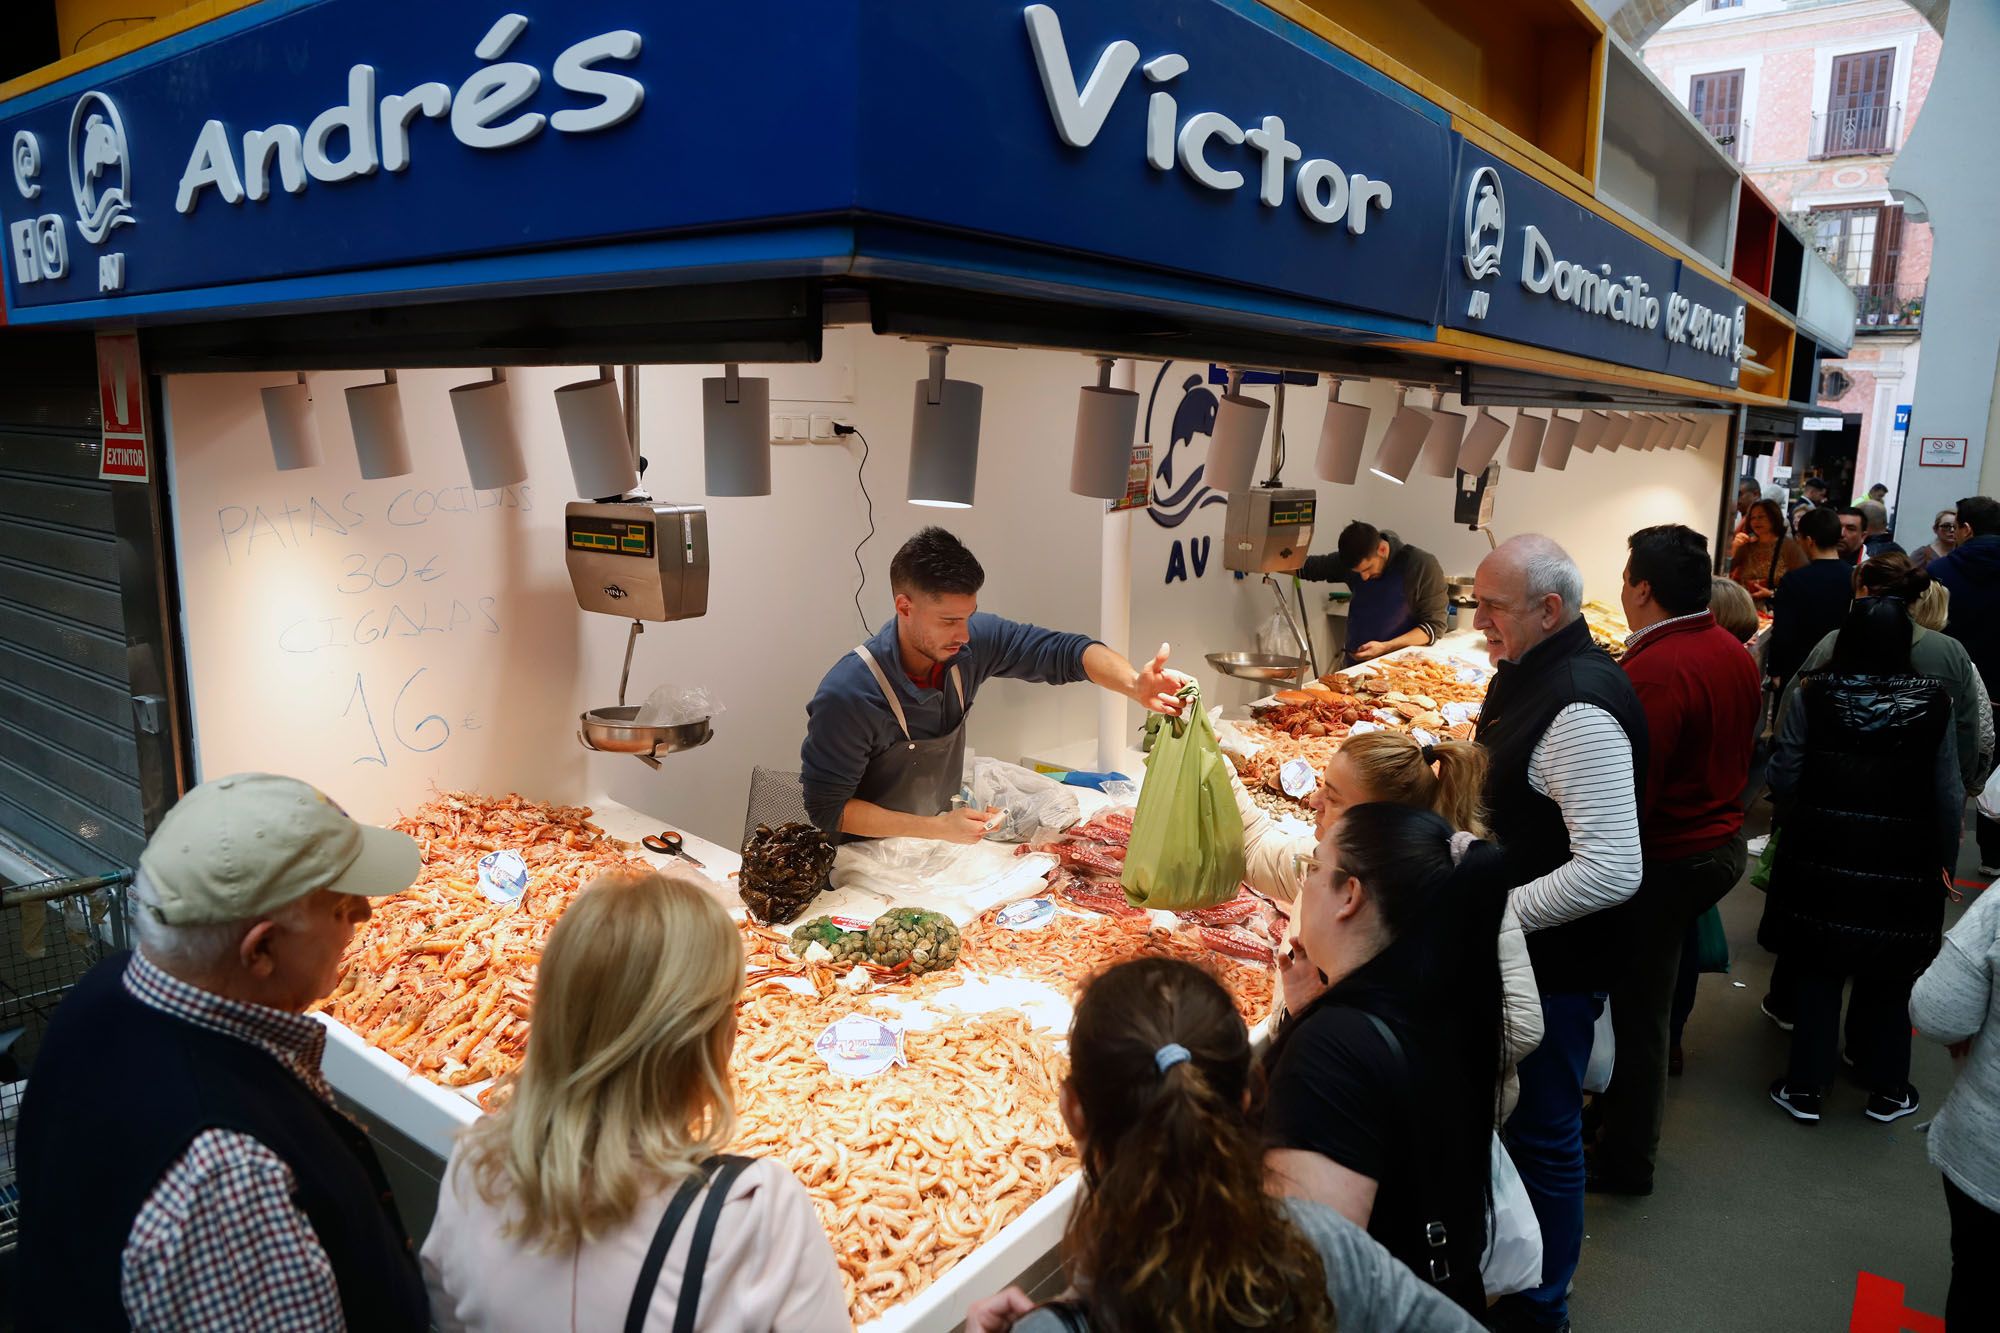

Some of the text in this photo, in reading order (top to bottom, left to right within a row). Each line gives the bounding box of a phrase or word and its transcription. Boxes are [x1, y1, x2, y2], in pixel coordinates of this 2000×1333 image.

[175, 13, 645, 214] Andrés
[1024, 4, 1393, 236] Víctor
[1521, 224, 1660, 330] Domicilio
[106, 447, 144, 467] EXTINTOR
[217, 486, 533, 566] PATAS COCIDAS
[1165, 535, 1211, 585] AV
[279, 597, 500, 653] CIGALAS
